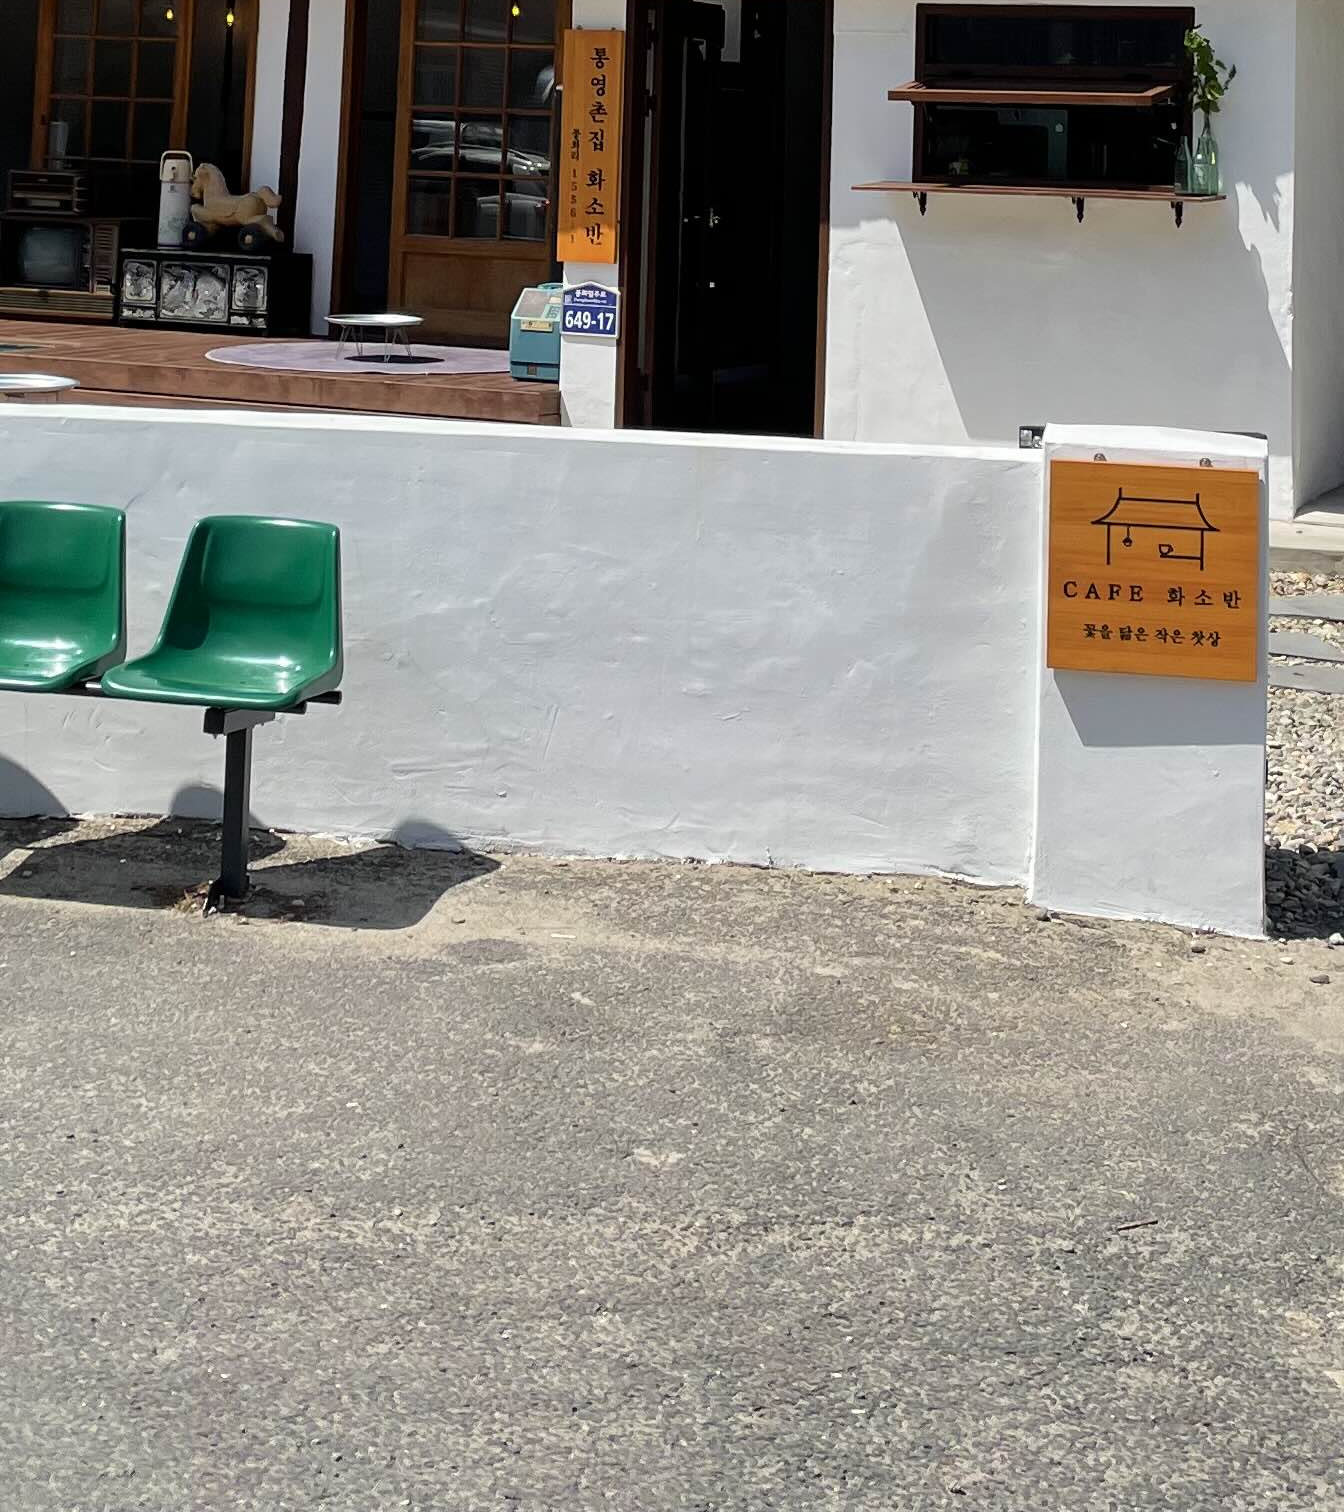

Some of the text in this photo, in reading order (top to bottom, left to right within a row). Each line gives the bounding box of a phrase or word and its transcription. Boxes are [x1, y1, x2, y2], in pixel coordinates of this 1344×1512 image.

[584, 47, 611, 246] 통영촌집 화소반
[565, 310, 615, 331] 649-17
[1063, 580, 1242, 610] CAFE 화소반
[1083, 623, 1114, 640] 꽃을
[1118, 625, 1150, 642] 닮은
[1154, 628, 1186, 645] 작은
